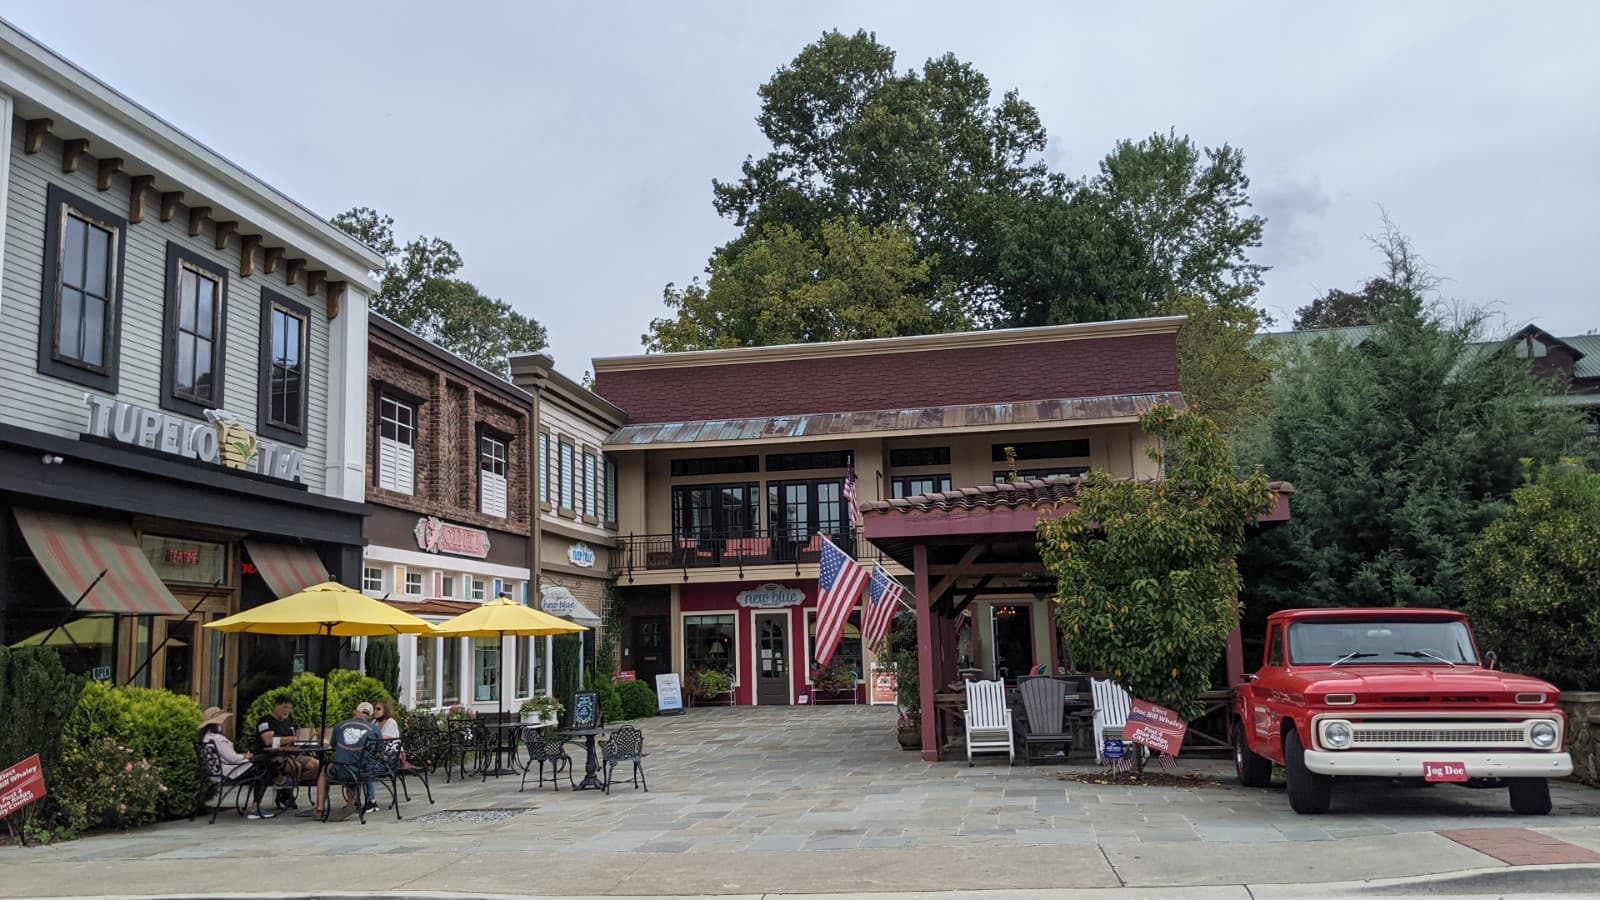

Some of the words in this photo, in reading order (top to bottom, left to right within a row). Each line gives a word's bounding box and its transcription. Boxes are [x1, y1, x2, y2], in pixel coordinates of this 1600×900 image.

[84, 392, 220, 464] TUPELO
[255, 441, 305, 484] TEA
[1159, 715, 1184, 729] Whaley
